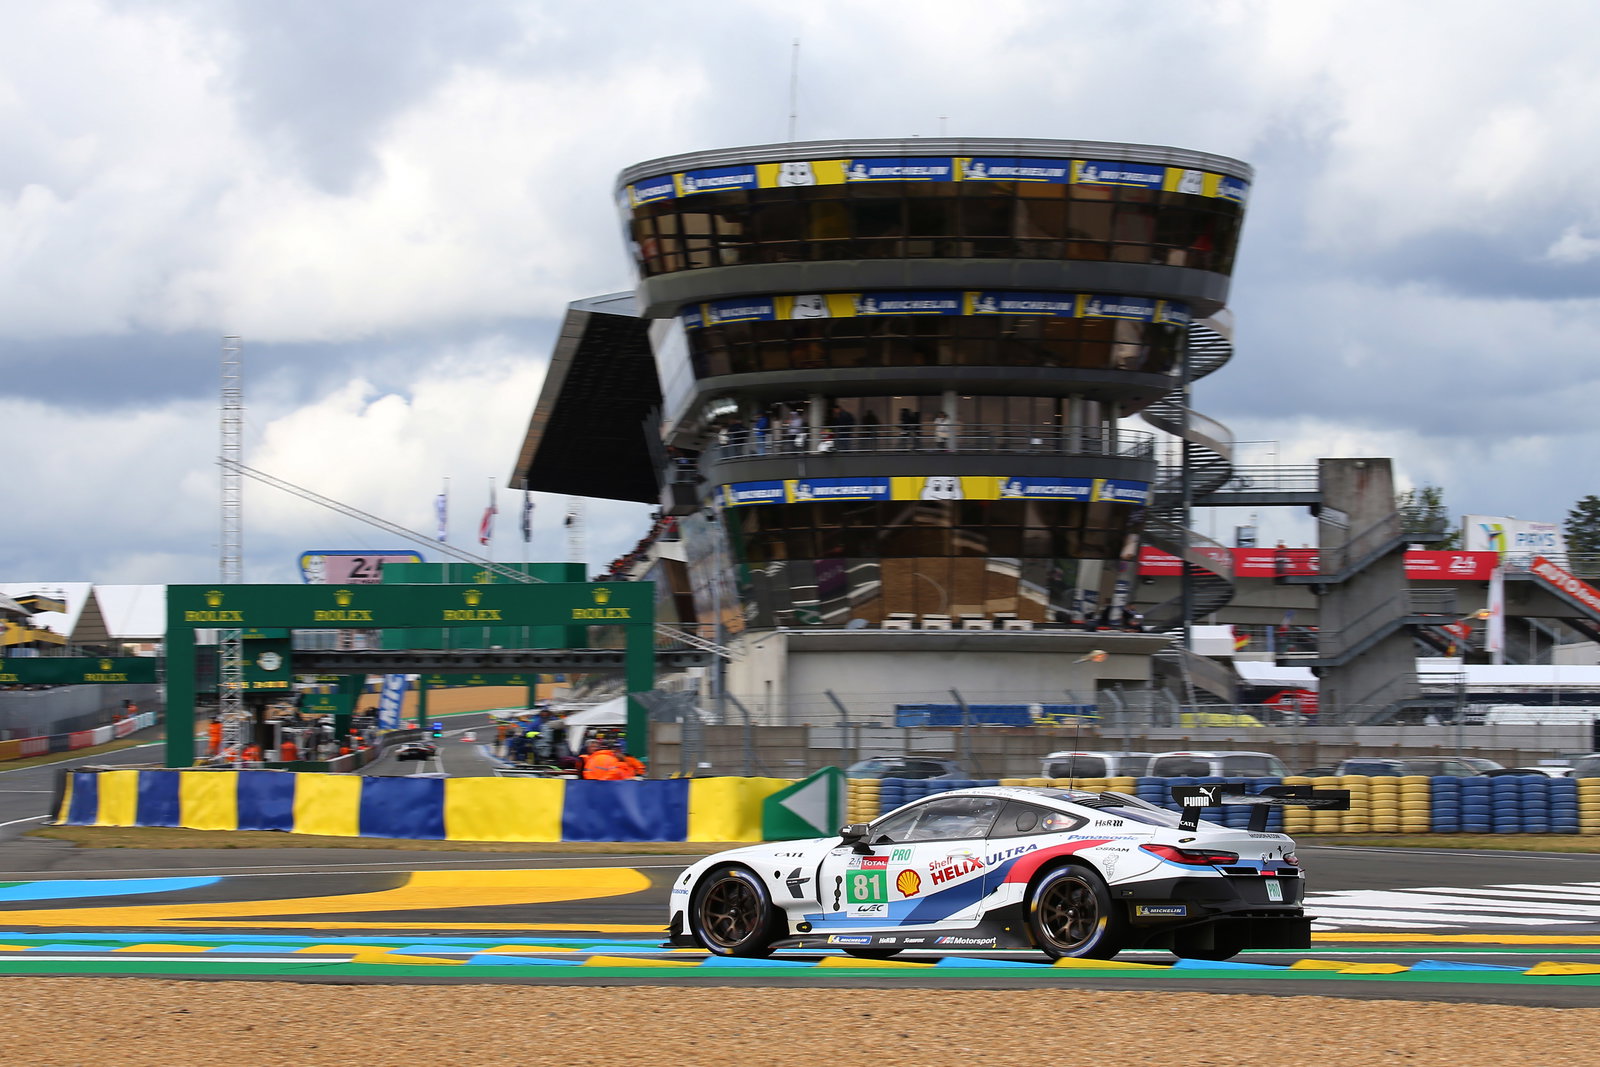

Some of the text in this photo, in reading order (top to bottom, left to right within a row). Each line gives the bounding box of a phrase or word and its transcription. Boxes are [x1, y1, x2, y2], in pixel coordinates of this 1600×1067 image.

[869, 166, 949, 176] MICHELIN
[988, 166, 1065, 177] MICHELIN
[879, 300, 957, 309] MICHELIN
[1000, 301, 1072, 310] MICHELIN
[813, 485, 888, 495] MICHELIN
[1025, 485, 1091, 495] MICHELIN
[184, 611, 244, 621] ROLEX
[314, 610, 373, 621] ROLEX
[442, 610, 502, 620] ROLEX
[572, 608, 631, 619] ROLEX
[83, 673, 128, 681] ROLEX
[1184, 796, 1209, 807] PUMA
[891, 849, 912, 861] PRO
[985, 843, 1038, 866] ULTRA
[929, 856, 953, 871] Shell
[931, 857, 984, 886] HELIX
[853, 874, 881, 900] 81
[858, 904, 884, 912] WEC
[954, 937, 996, 945] Motorsport
